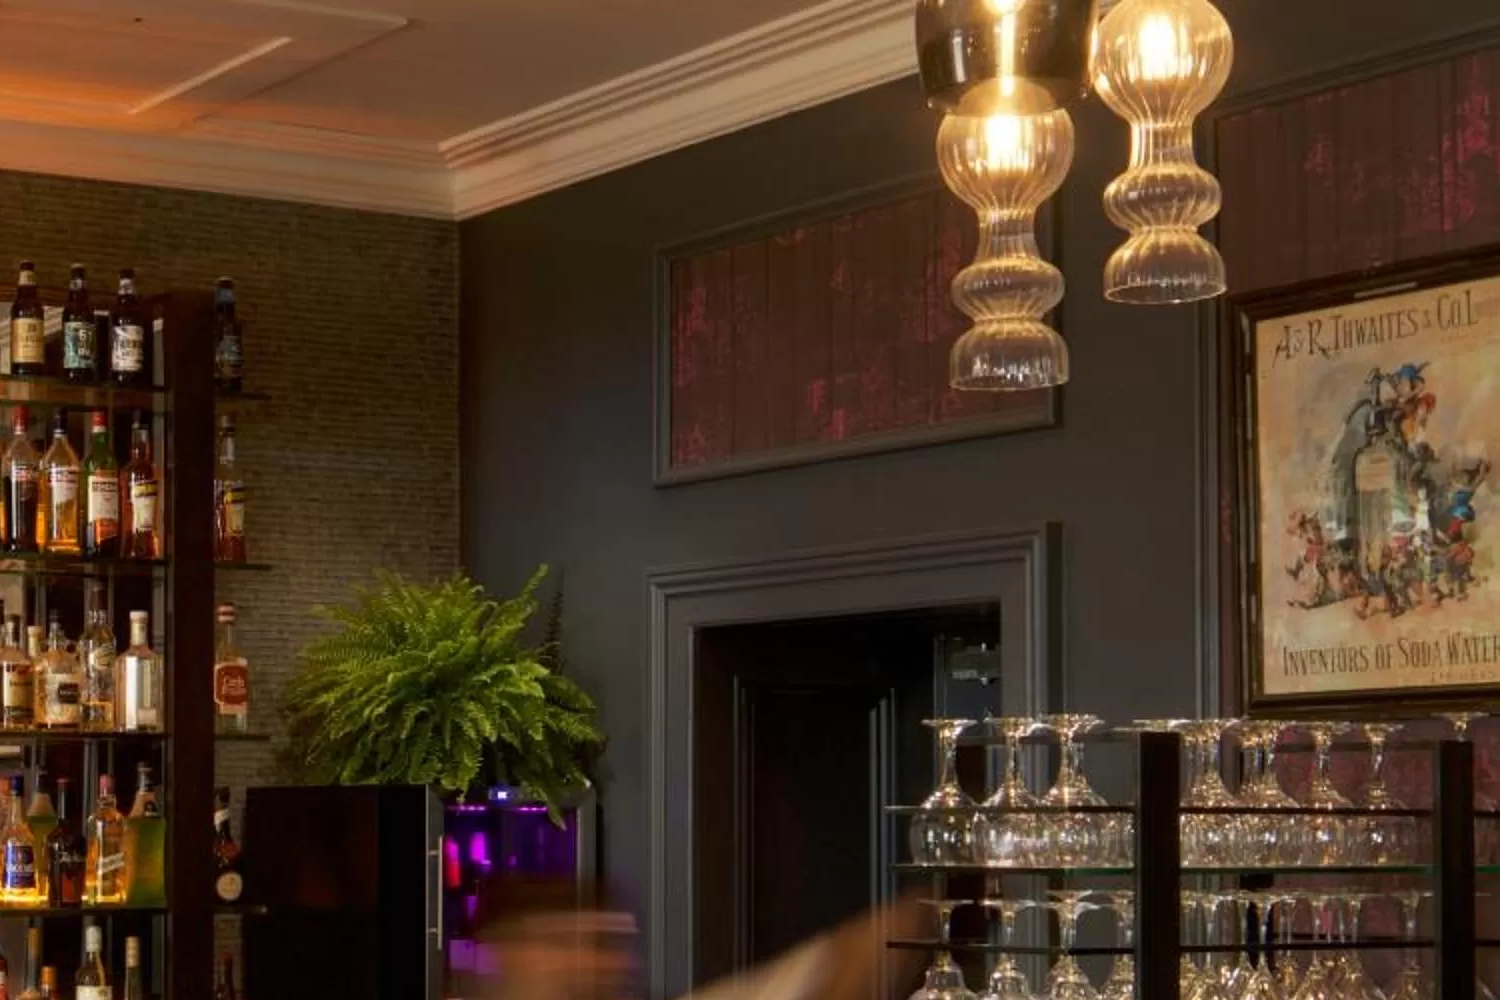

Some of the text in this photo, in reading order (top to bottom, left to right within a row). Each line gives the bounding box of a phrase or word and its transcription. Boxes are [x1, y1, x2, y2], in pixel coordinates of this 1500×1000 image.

[1329, 308, 1419, 352] THWAITES
[1283, 644, 1369, 677] INVENTORS
[1375, 643, 1393, 670] OF
[1397, 635, 1443, 669] SODA
